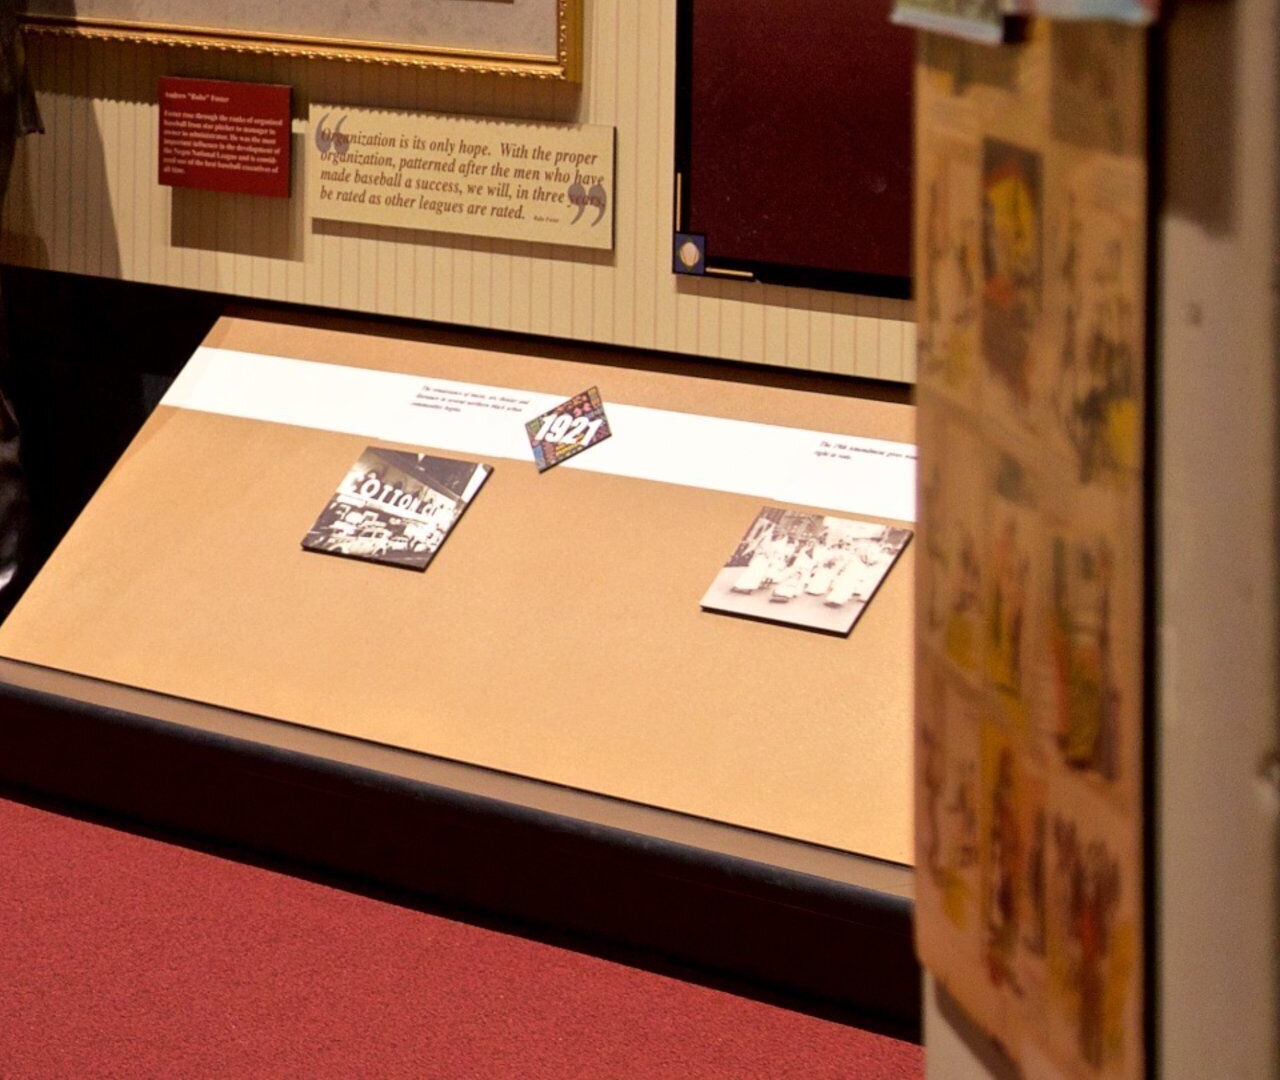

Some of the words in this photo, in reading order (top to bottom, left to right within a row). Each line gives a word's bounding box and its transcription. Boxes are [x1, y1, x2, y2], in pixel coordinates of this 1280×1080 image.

[320, 125, 396, 149] Organization
[399, 134, 409, 150] is
[412, 136, 426, 151] its
[429, 138, 456, 157] only
[459, 138, 492, 158] hope.
[501, 141, 530, 161] With
[532, 143, 552, 162] the
[554, 148, 599, 167] proper
[320, 149, 397, 170] organization,
[398, 156, 456, 174] patterned
[458, 161, 488, 178] after
[491, 161, 511, 178] the
[513, 166, 541, 182] men
[544, 165, 571, 185] who
[574, 170, 605, 188] have
[320, 167, 351, 184] made
[354, 170, 402, 188] baseball
[404, 177, 412, 189] a
[415, 179, 463, 197] success,
[467, 182, 485, 197] we
[487, 180, 513, 201] will,
[516, 186, 529, 201] in
[532, 186, 565, 204] three
[320, 184, 334, 201] be
[336, 186, 366, 205] rated
[368, 192, 382, 206] as
[384, 190, 416, 209] other
[418, 193, 464, 216] leagues
[466, 201, 488, 217] are
[490, 201, 527, 221] rated.
[535, 412, 604, 447] 1921
[343, 470, 420, 515] COTTON
